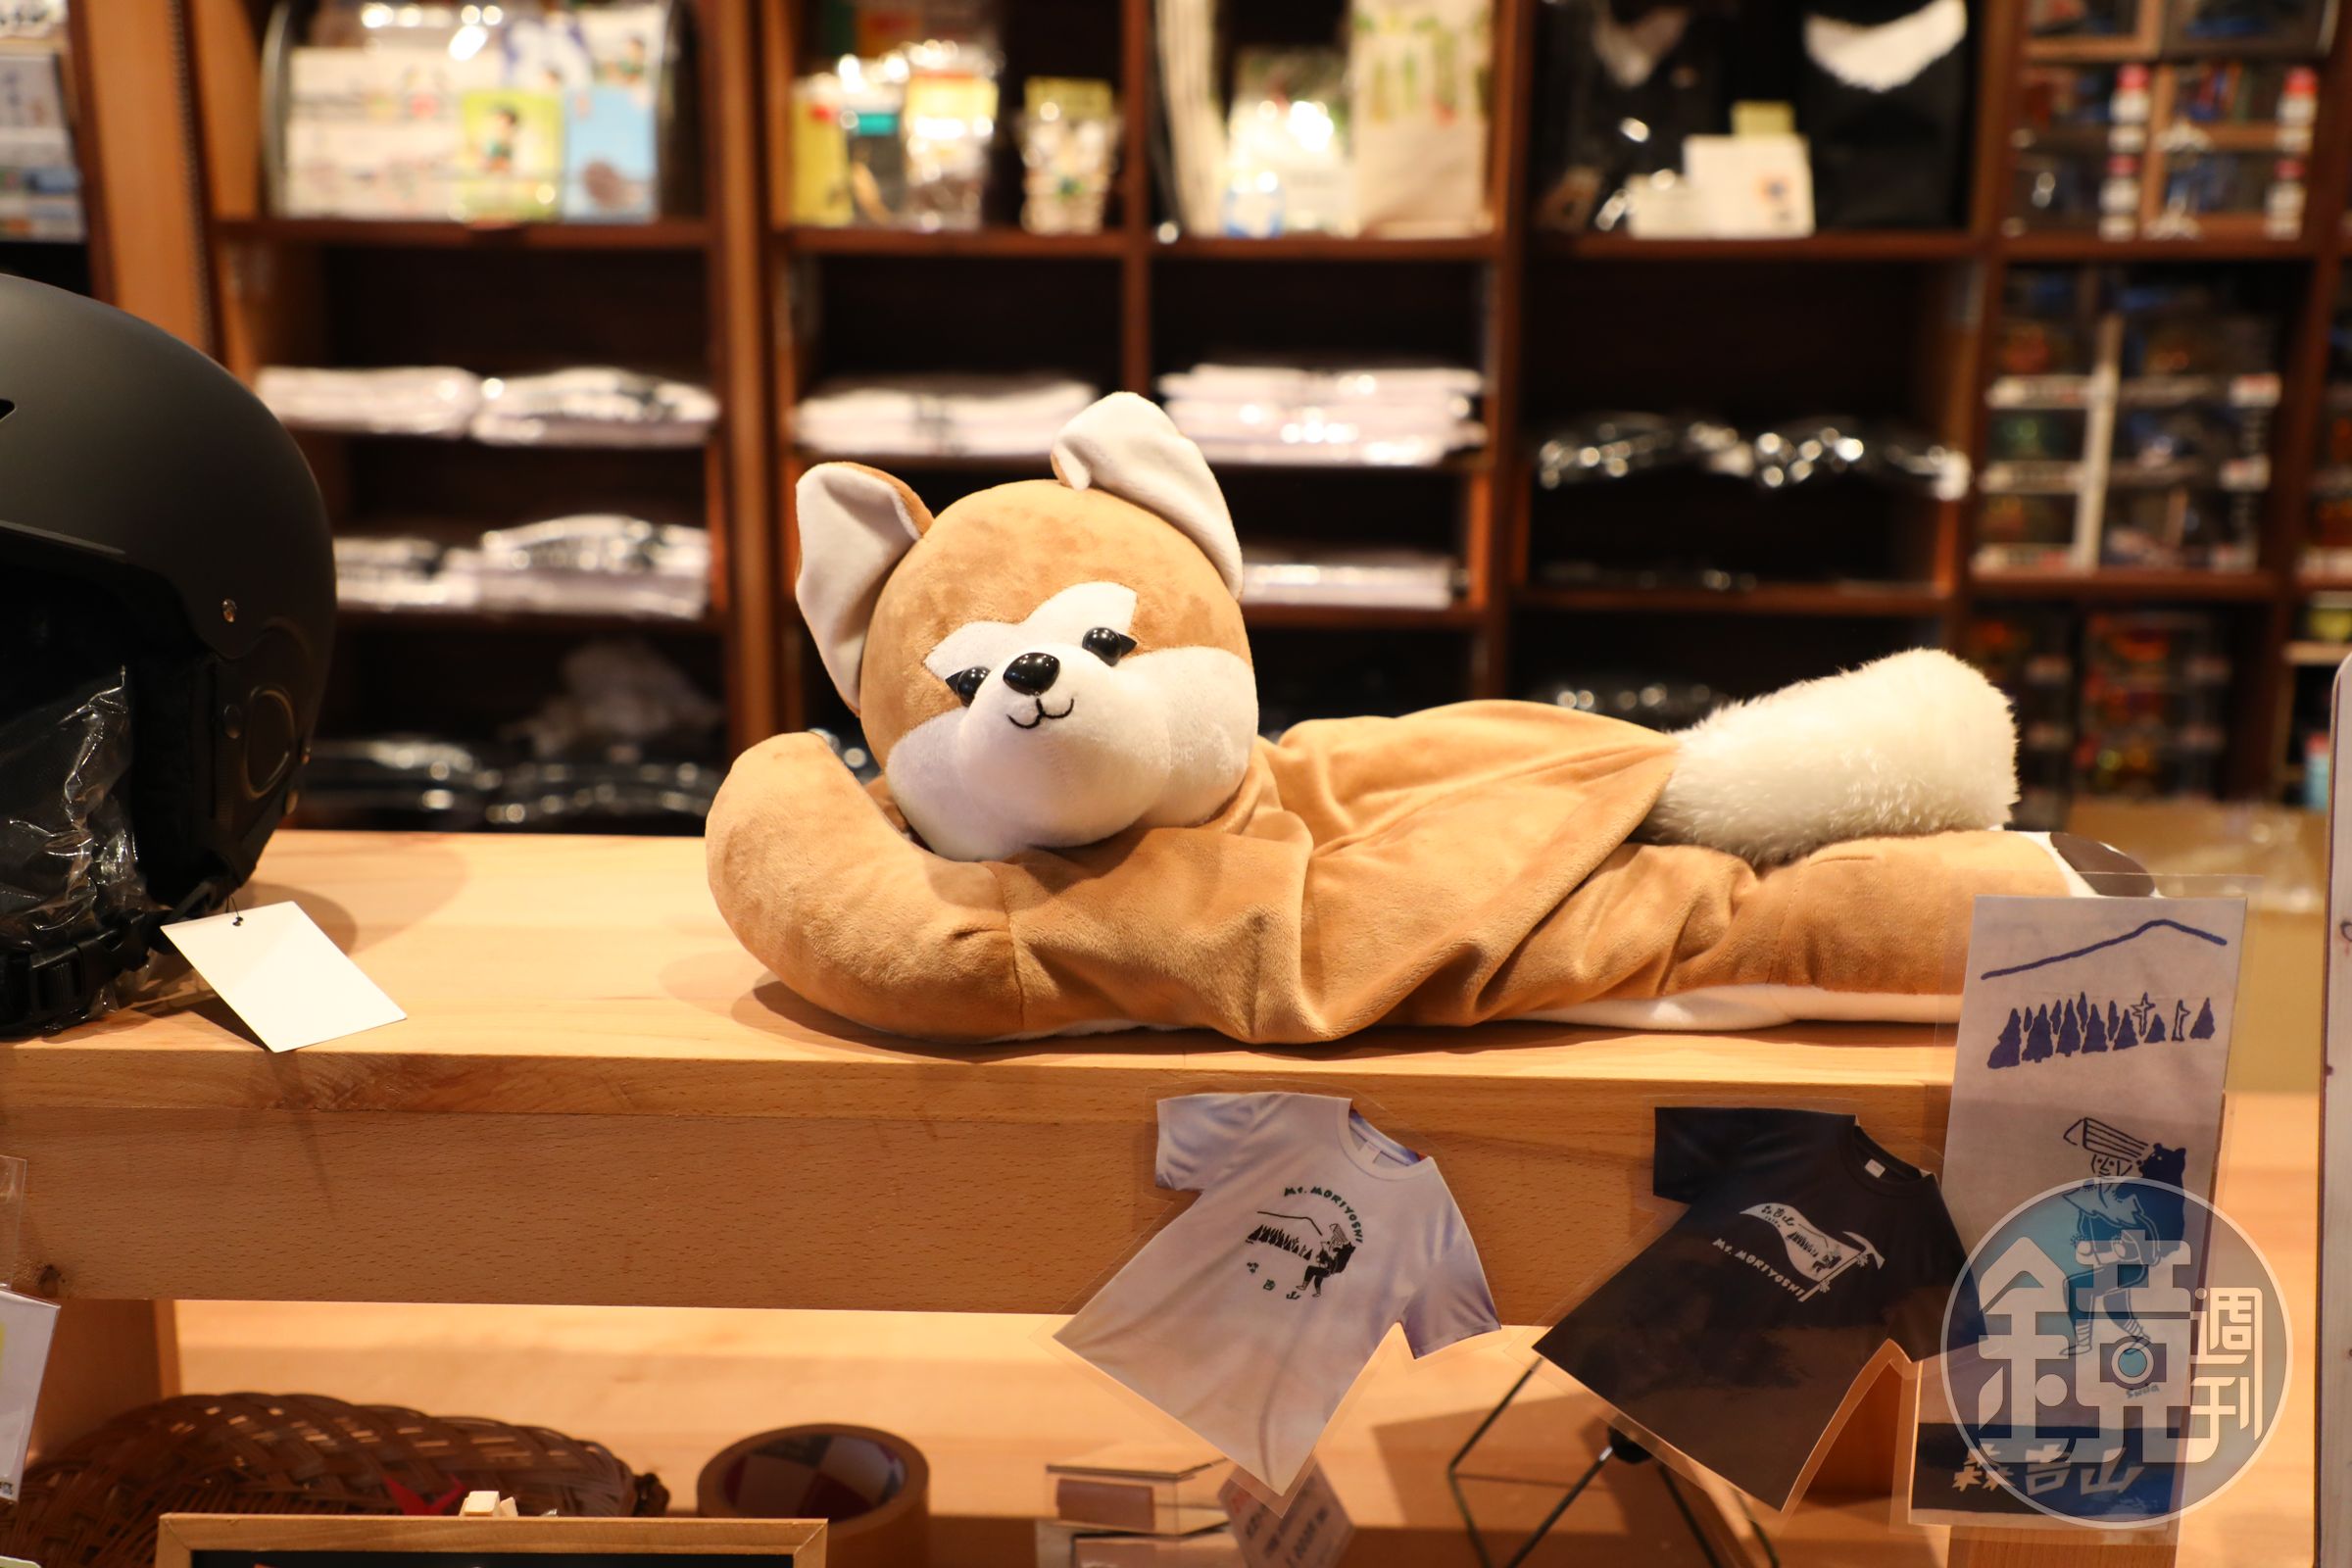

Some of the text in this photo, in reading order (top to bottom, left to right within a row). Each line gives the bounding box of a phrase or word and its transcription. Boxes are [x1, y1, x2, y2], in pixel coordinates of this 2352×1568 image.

[1310, 1186, 1363, 1244] MORIYOSHI
[1734, 1250, 1806, 1298] MORIYOSHI
[1951, 1442, 2146, 1496] 森吉山
